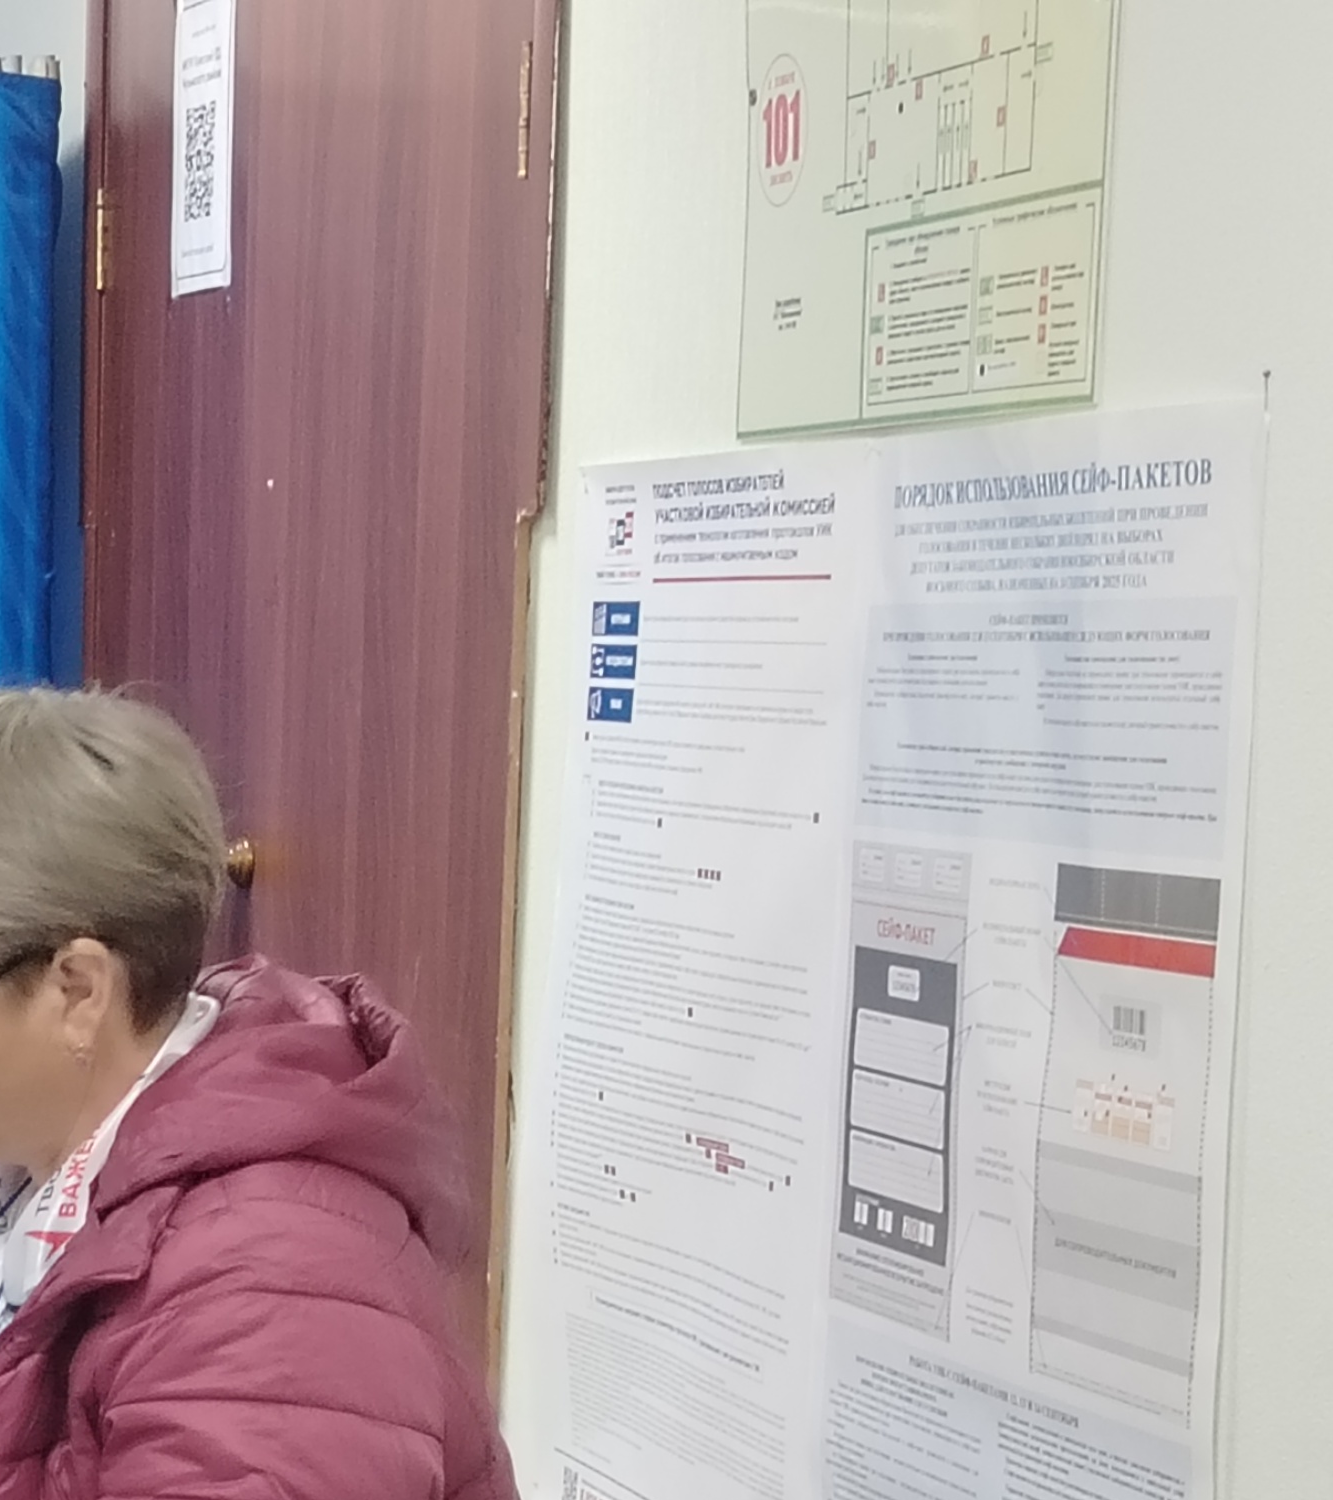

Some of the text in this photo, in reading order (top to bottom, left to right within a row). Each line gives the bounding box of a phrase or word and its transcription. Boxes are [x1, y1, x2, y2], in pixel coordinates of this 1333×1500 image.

[762, 89, 801, 169] 101
[956, 470, 1069, 505] ИСПОЛЬЗОВАНИЯ
[1072, 458, 1213, 495] СЕЙФ-ПАКЕТОВ
[772, 492, 835, 516] КОМИССИЕЙ
[877, 917, 936, 945] СЕЙФ-ПАКЕТ
